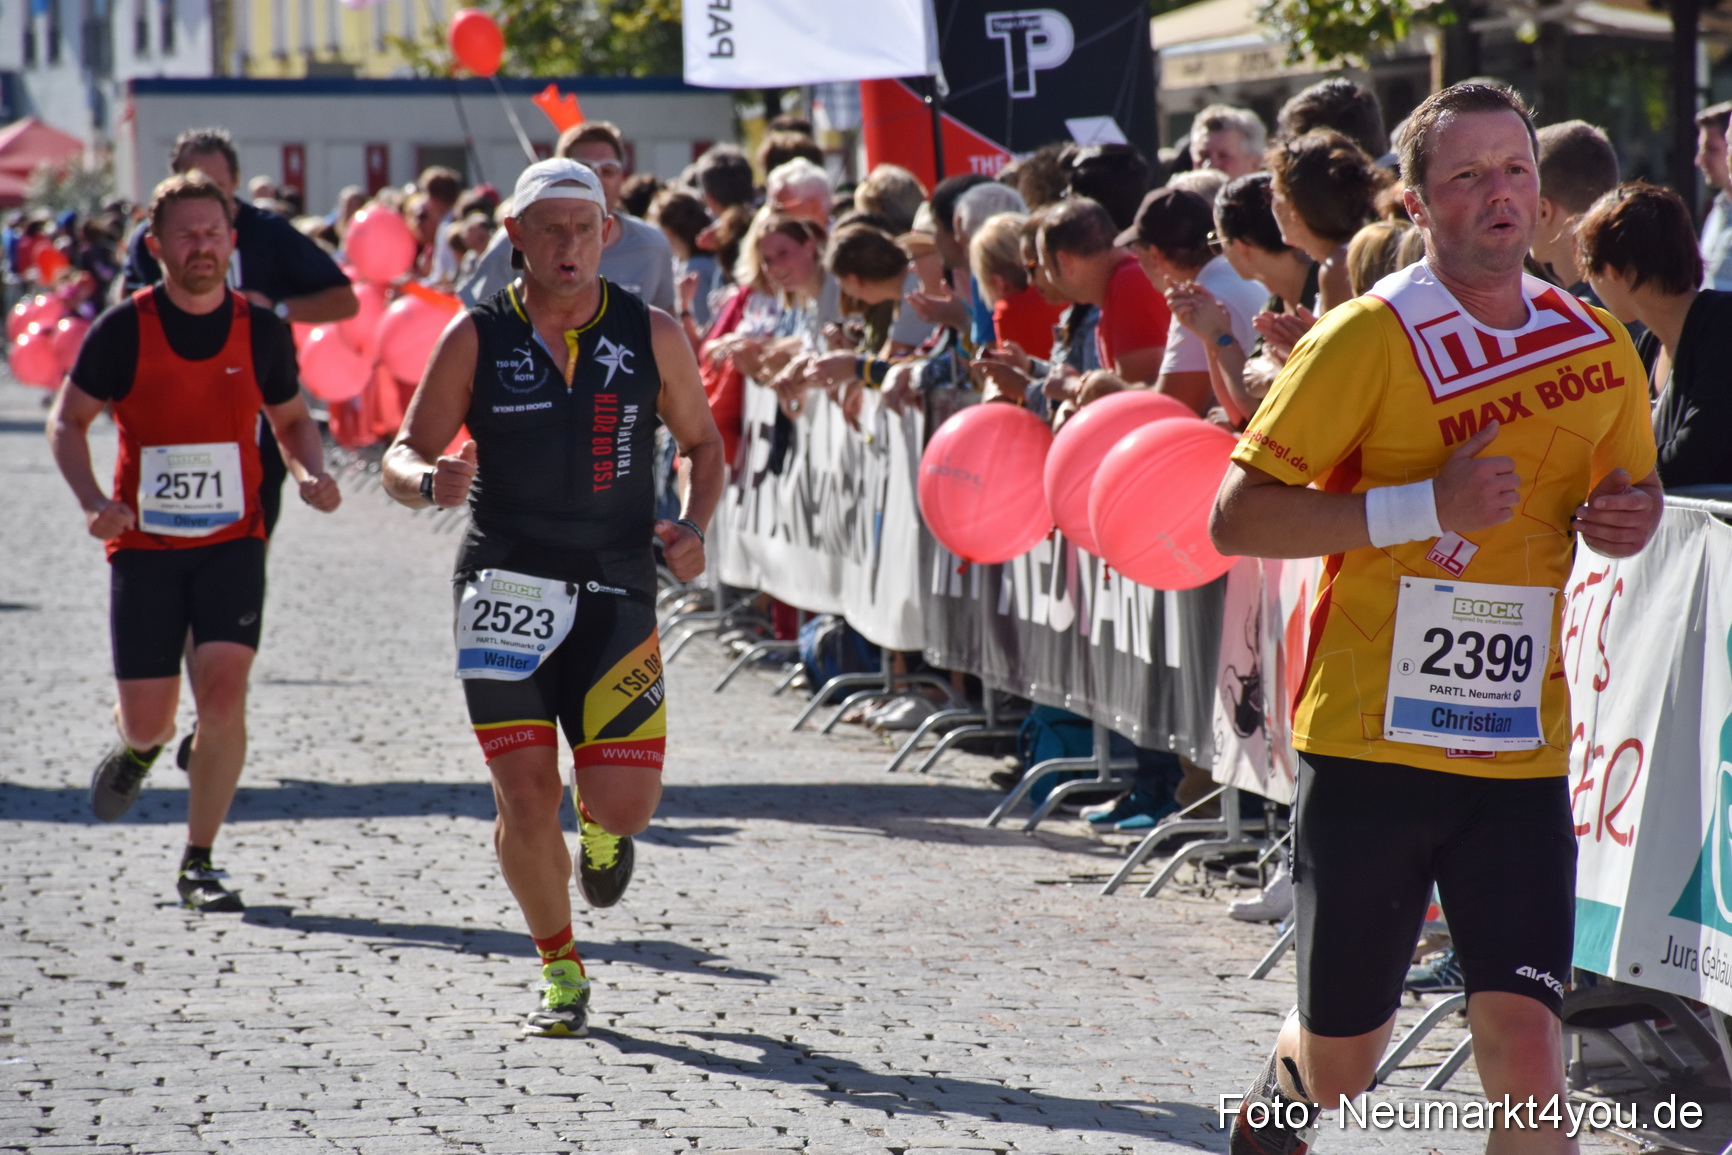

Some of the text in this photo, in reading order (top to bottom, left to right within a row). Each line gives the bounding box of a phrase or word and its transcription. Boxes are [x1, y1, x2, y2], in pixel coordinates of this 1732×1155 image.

[593, 393, 618, 433] ROTH
[1438, 360, 1626, 447] MAX BÖGL
[617, 404, 639, 478] TRIATHLON
[155, 470, 223, 499] 2571
[593, 461, 614, 493] TSG
[174, 514, 209, 528] Oliver
[491, 579, 543, 599] BOCK
[472, 599, 555, 640] 2523
[1452, 614, 1476, 622] inspired
[1453, 597, 1524, 620] BOCK
[476, 636, 535, 650] PARTL Neumarkt
[1420, 627, 1533, 683] 2399
[484, 651, 530, 670] Walter
[1402, 662, 1410, 671] B
[612, 668, 650, 698] TSG
[1429, 684, 1511, 701] PARTL Neumarkt
[1431, 706, 1512, 733] Christian
[1661, 935, 1699, 974] Jura
